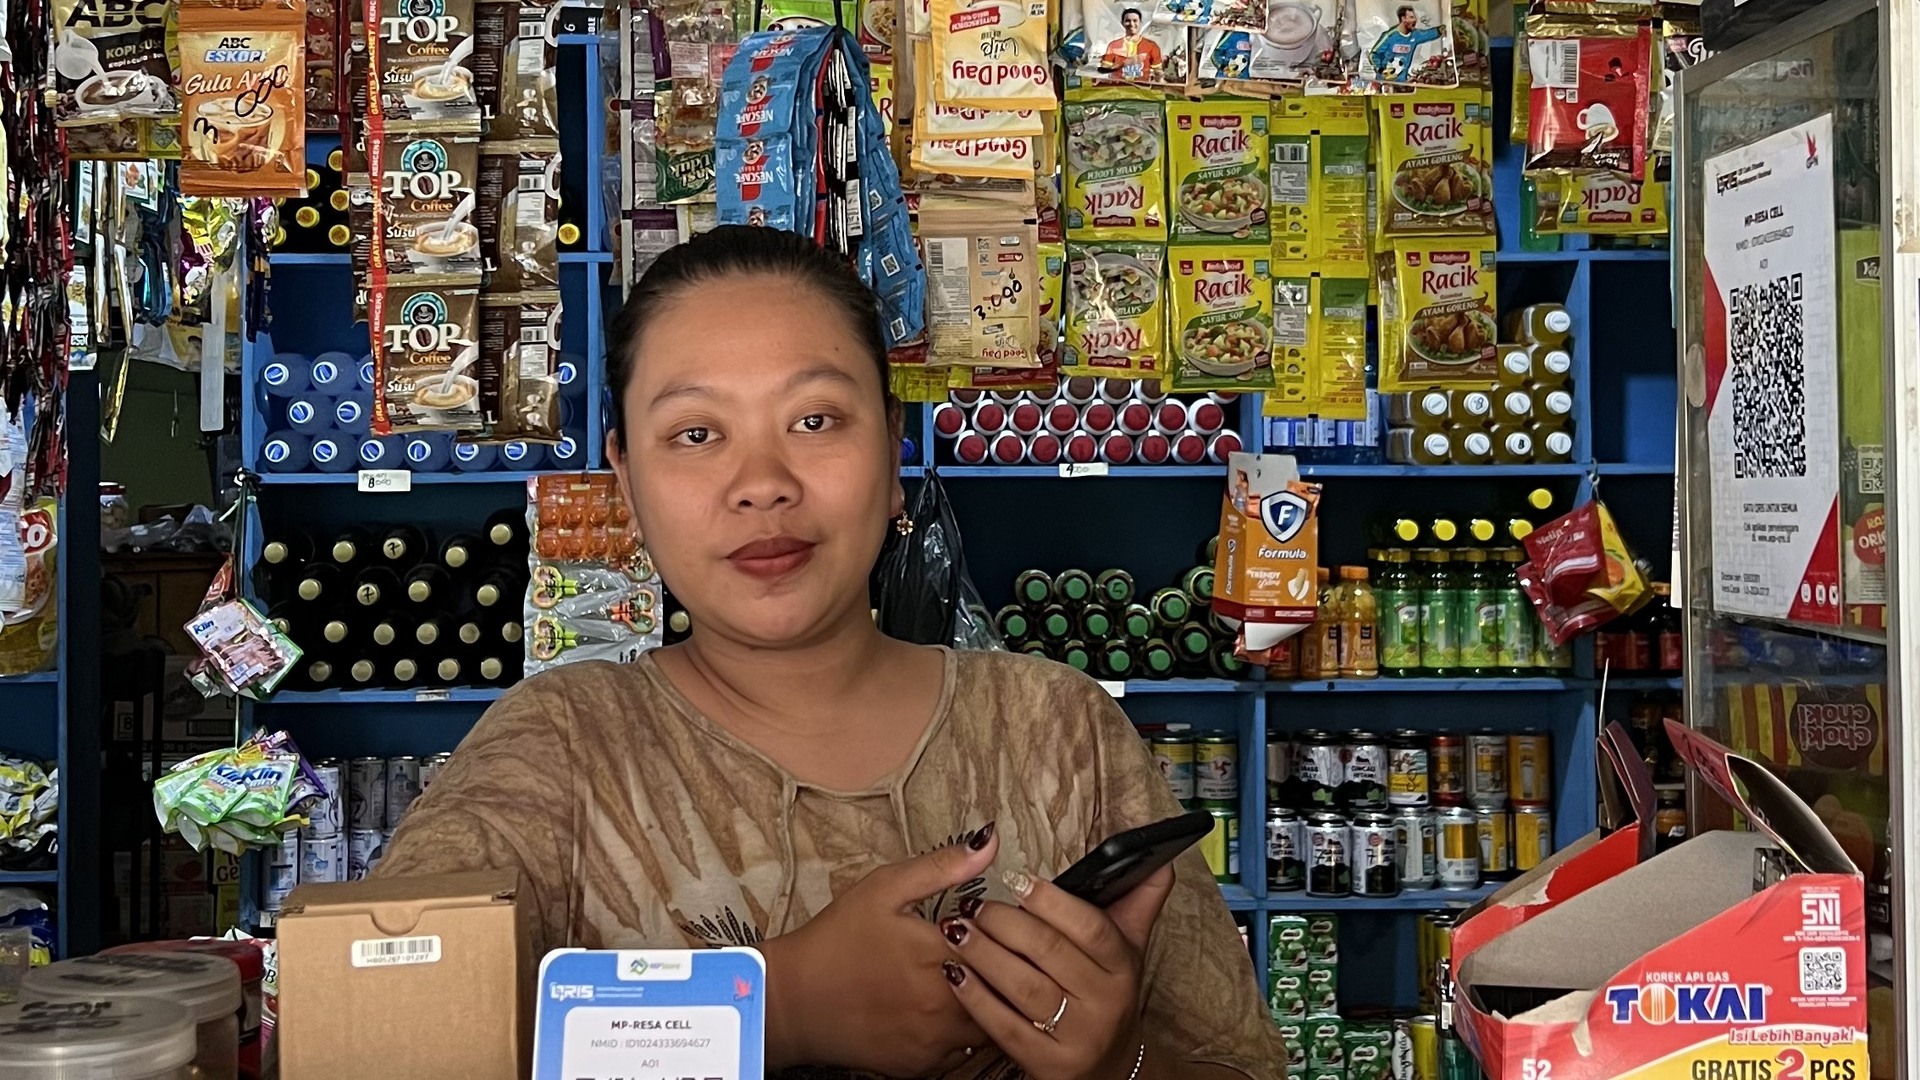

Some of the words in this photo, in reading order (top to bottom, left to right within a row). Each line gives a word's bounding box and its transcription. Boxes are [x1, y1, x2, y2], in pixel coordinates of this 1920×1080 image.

[64, 0, 163, 27] ABC
[380, 16, 459, 44] TOP
[105, 44, 137, 60] KOPI
[218, 37, 253, 49] ABC
[407, 43, 450, 56] Coffee
[185, 72, 233, 95] Gula
[383, 71, 413, 84] Susu
[952, 60, 992, 86] Day
[997, 65, 1048, 86] Good
[368, 80, 379, 115] GRATIS
[1405, 117, 1464, 147] Racik
[974, 138, 1027, 160] Good
[1191, 130, 1251, 159] Racik
[669, 154, 711, 178] Uduk
[1116, 163, 1143, 176] SAYUR
[1405, 157, 1429, 168] AYAM
[1431, 152, 1464, 165] GORENG
[681, 164, 716, 187] Nasi
[1198, 168, 1224, 180] SAYUR
[1226, 166, 1243, 176] SOP
[383, 171, 463, 201] TOP
[1581, 183, 1642, 209] Racik
[410, 200, 454, 213] Coffee
[1084, 185, 1145, 215] Racik
[386, 227, 417, 239] Susu
[1194, 273, 1252, 303] Racik
[1421, 265, 1479, 295] Racik
[1200, 314, 1227, 325] SAYUR
[1228, 310, 1245, 320] SOP
[1421, 305, 1445, 317] AYAM
[1446, 301, 1479, 313] GORENG
[383, 323, 462, 353] TOP
[1081, 328, 1142, 354] Racik
[409, 352, 452, 365] Coffee
[982, 348, 1003, 360] Day
[1003, 348, 1028, 359] Good
[387, 380, 417, 393] Susu
[1277, 505, 1294, 526] F
[387, 542, 400, 556] 7
[1258, 547, 1308, 559] Formula
[1225, 555, 1234, 595] Formula
[362, 586, 375, 603] 7
[1802, 899, 1841, 926] SNI
[1646, 972, 1682, 983] KOREK
[1685, 972, 1704, 982] API
[1707, 971, 1730, 982] GAS
[1606, 983, 1766, 1025] TOKAI
[610, 1020, 662, 1030] MP-RESA
[665, 1020, 693, 1030] CELL
[591, 1039, 618, 1048] NMID
[1729, 1028, 1749, 1043] Isi
[1751, 1027, 1791, 1043] Lebih
[1793, 1027, 1855, 1047] Banyak!
[1522, 1059, 1551, 1080] 52
[1691, 1059, 1772, 1080] GRATIS
[1775, 1048, 1805, 1080] 2
[1810, 1059, 1856, 1080] PCS
